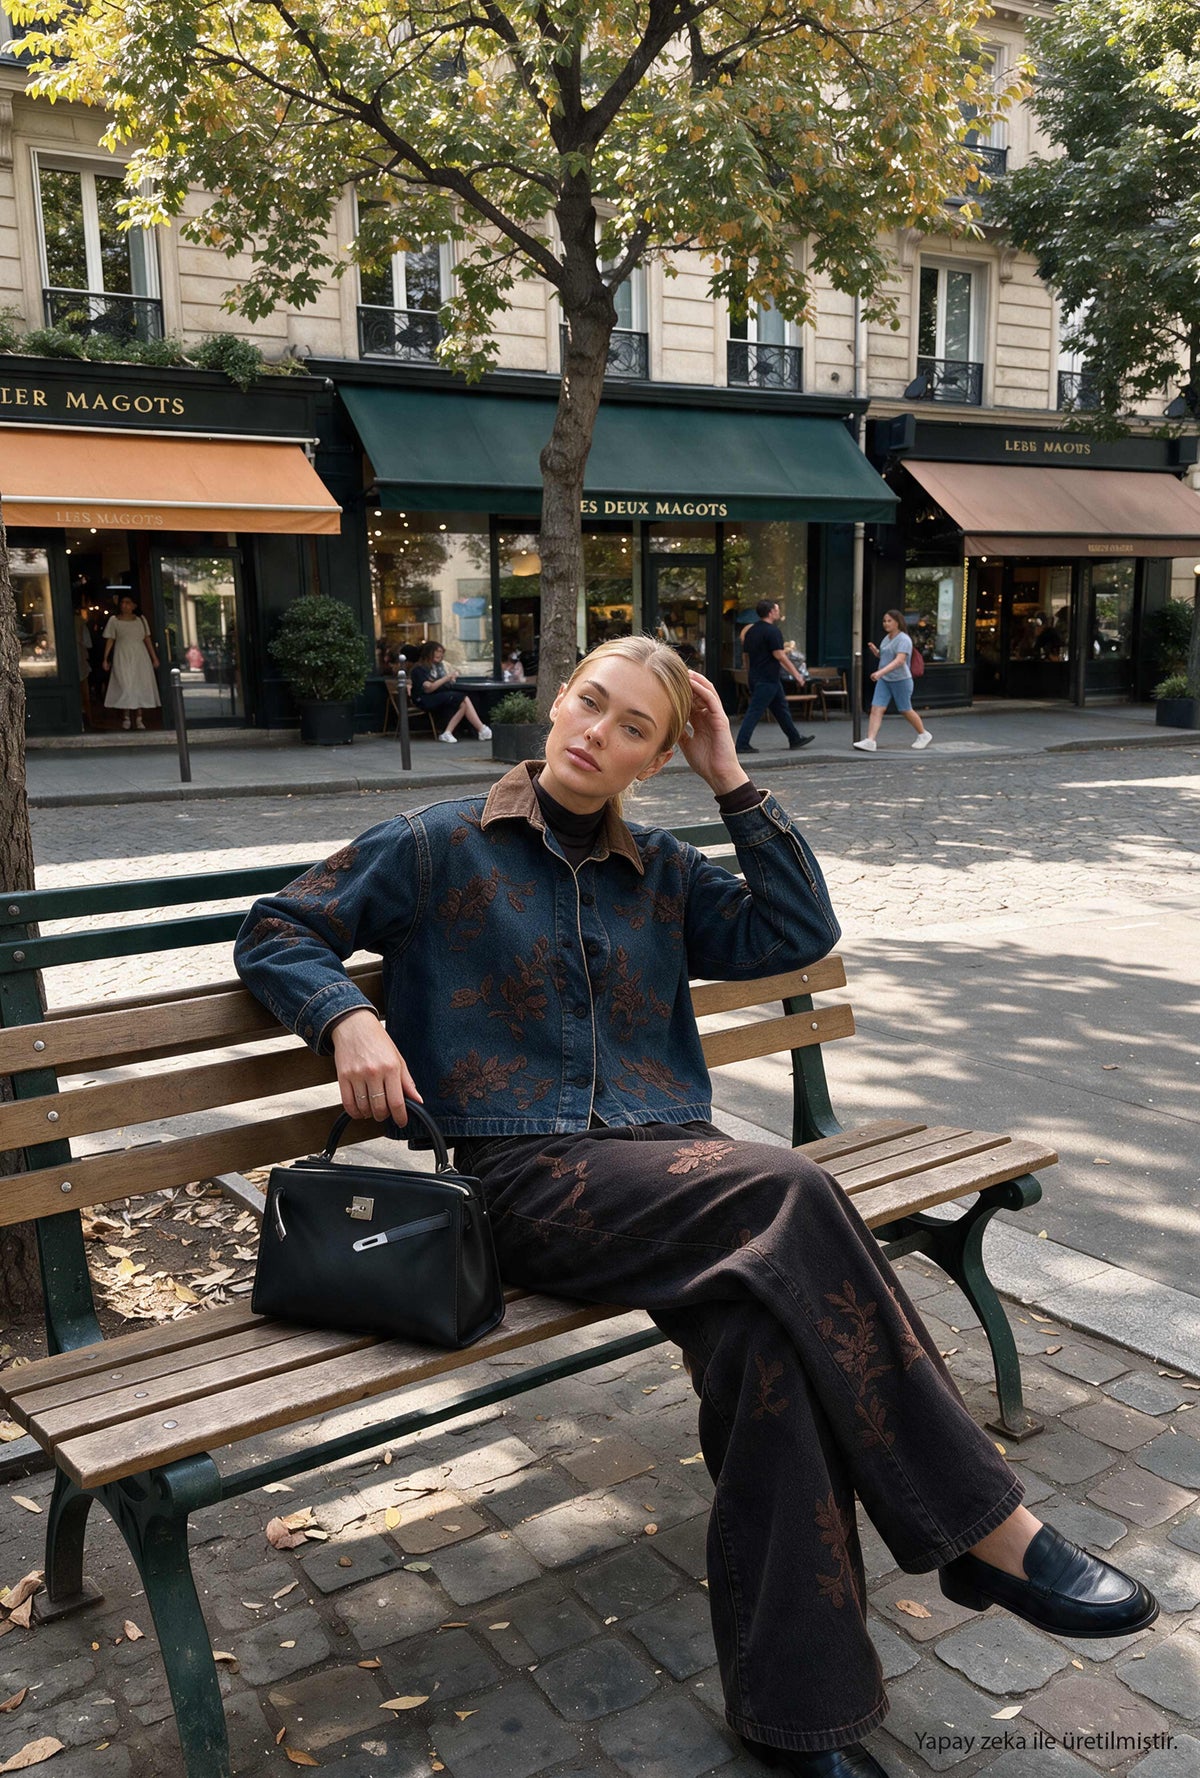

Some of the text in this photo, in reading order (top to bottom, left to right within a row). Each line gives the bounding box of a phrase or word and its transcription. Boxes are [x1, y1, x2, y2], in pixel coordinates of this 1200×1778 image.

[66, 392, 185, 415] MAGOTS
[580, 500, 728, 517] ES DEUX MAGOTS
